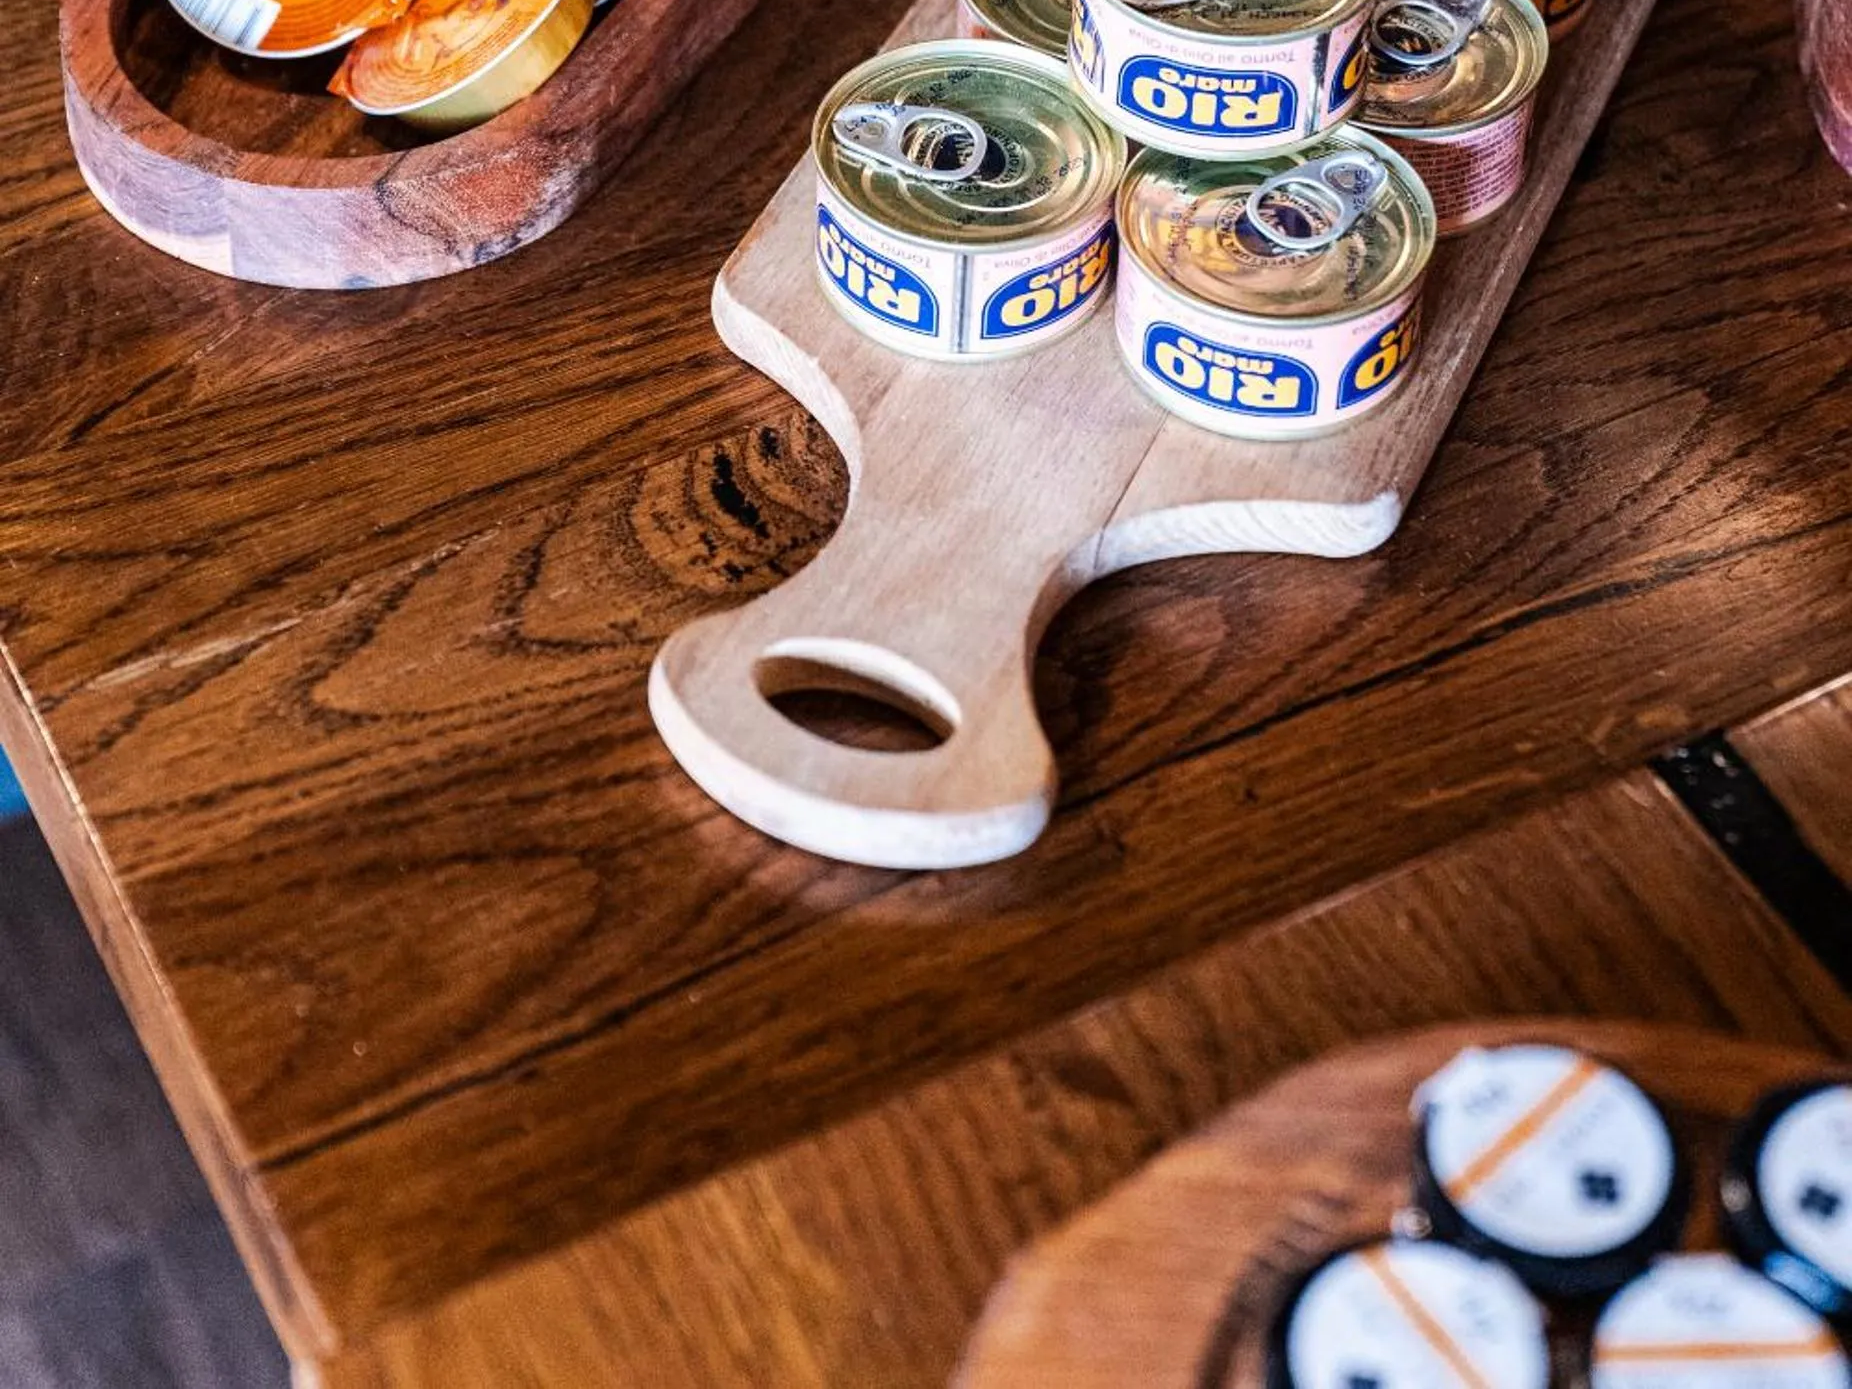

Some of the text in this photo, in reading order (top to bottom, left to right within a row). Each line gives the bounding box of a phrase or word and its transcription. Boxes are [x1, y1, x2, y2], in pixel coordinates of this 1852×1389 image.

[1158, 67, 1257, 94] mare
[1240, 49, 1296, 65] Tonno
[1131, 75, 1284, 129] RIO
[819, 225, 922, 324] RIO
[829, 223, 897, 281] mare
[1000, 241, 1109, 327] RIO
[1154, 341, 1300, 409] RIO
[1176, 335, 1274, 374] mare
